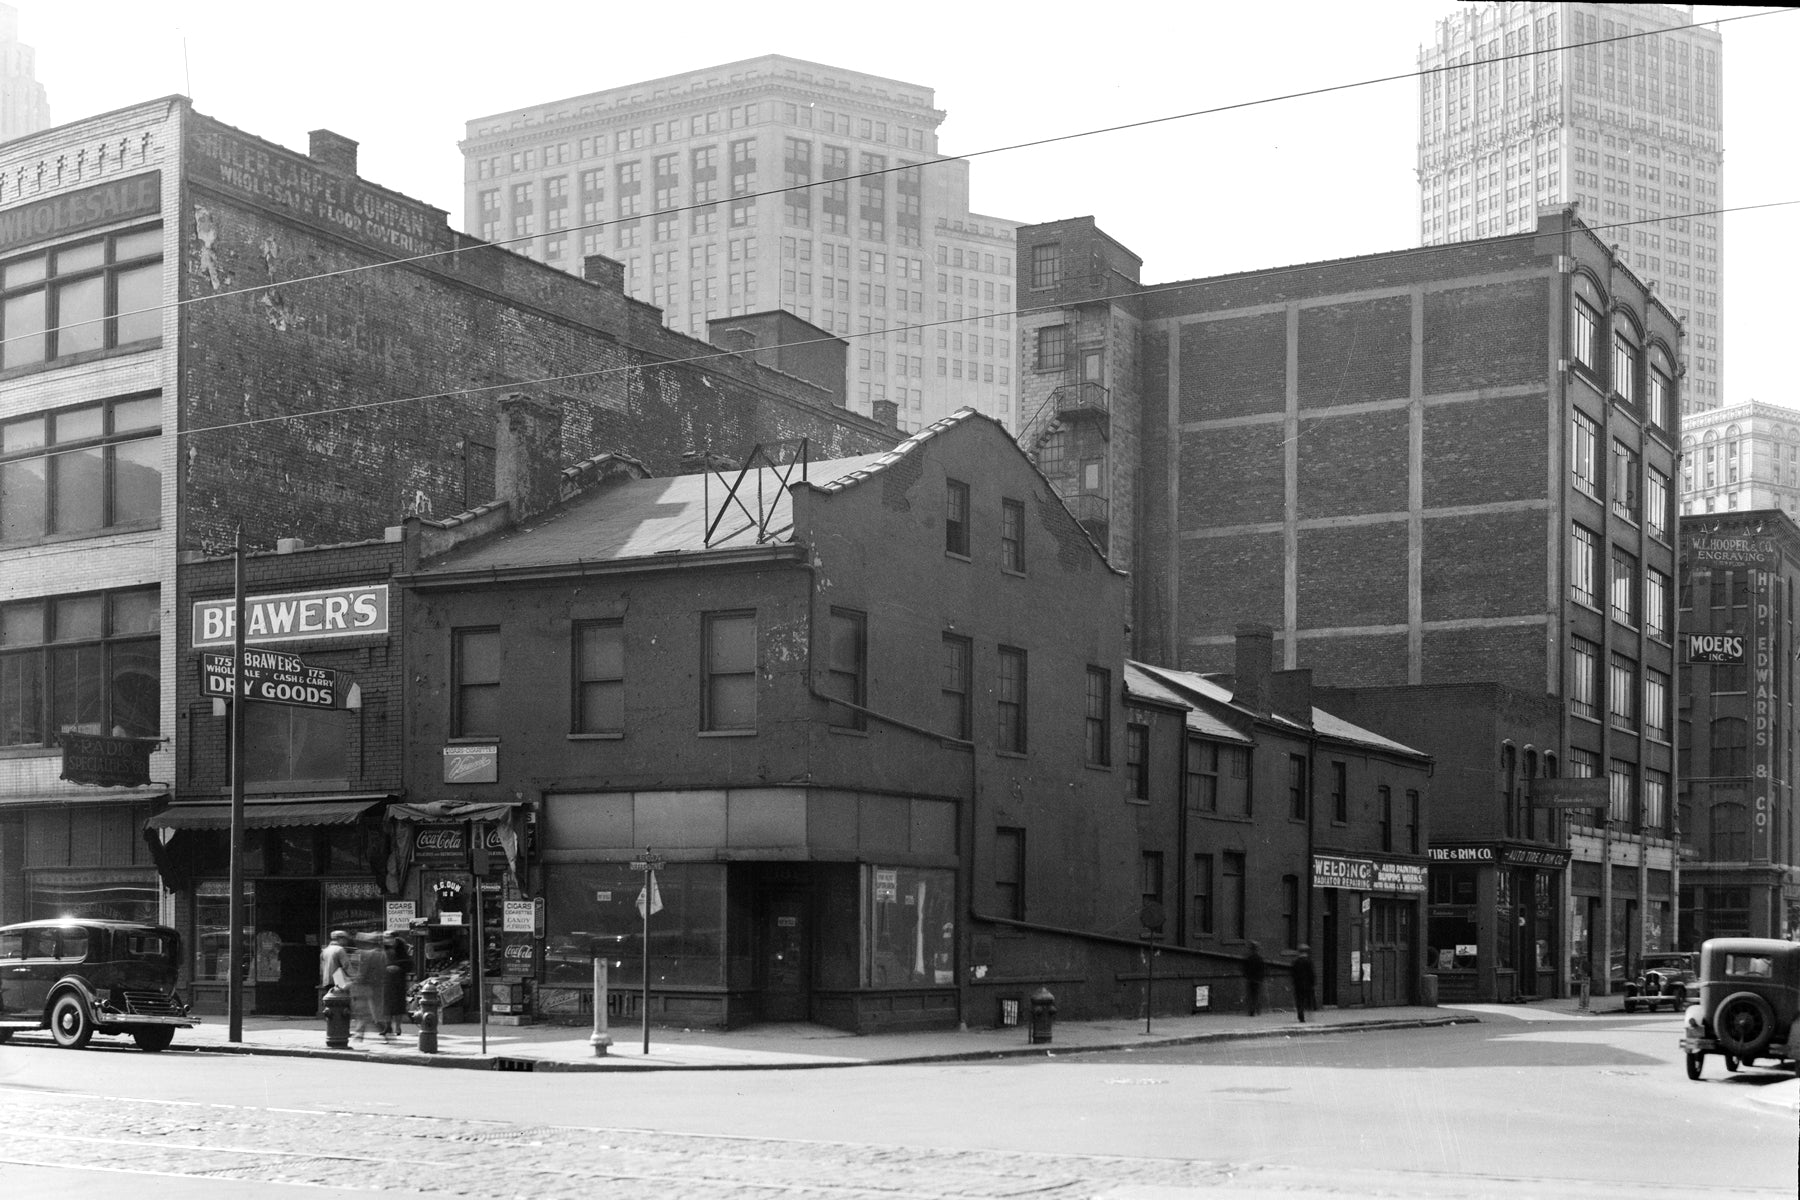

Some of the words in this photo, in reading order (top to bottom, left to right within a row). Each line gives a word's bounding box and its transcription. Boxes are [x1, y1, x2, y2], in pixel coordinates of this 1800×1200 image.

[276, 160, 347, 204] CARPET
[220, 164, 314, 214] WHOLESALE
[319, 202, 362, 233] FLOOR
[1711, 538, 1750, 551] HOOPER
[1758, 541, 1774, 553] CO.
[1698, 551, 1765, 562] ENGRAVING
[203, 593, 378, 640] BRAWER'S
[1691, 636, 1742, 658] MOERS
[214, 657, 232, 667] 175
[244, 652, 301, 673] BRAWER'S
[308, 670, 326, 679] 175
[1708, 653, 1727, 661] INC.
[273, 673, 297, 683] CASH
[299, 676, 304, 684] &
[306, 677, 334, 687] CARRY
[210, 675, 254, 696] DRY
[262, 682, 332, 705] GOODS
[1756, 637, 1769, 746] EDWARDS
[81, 739, 134, 757] RADIO
[69, 756, 129, 774] SPECIALTIES
[1756, 764, 1768, 778] &
[1755, 796, 1767, 833] CO.
[1428, 848, 1450, 860] TIRE
[1450, 850, 1458, 859] &
[1458, 848, 1476, 860] RIM
[1477, 848, 1493, 860] CO.
[1315, 859, 1367, 879] WELDING
[1382, 863, 1395, 873] AUTO
[1396, 864, 1420, 875] PAINTING
[1314, 875, 1341, 886] RADIATOR
[1342, 877, 1370, 889] REPAIRING
[1402, 874, 1422, 884] WORKS
[506, 902, 532, 910] CIGARS
[583, 993, 622, 1015] NHI
